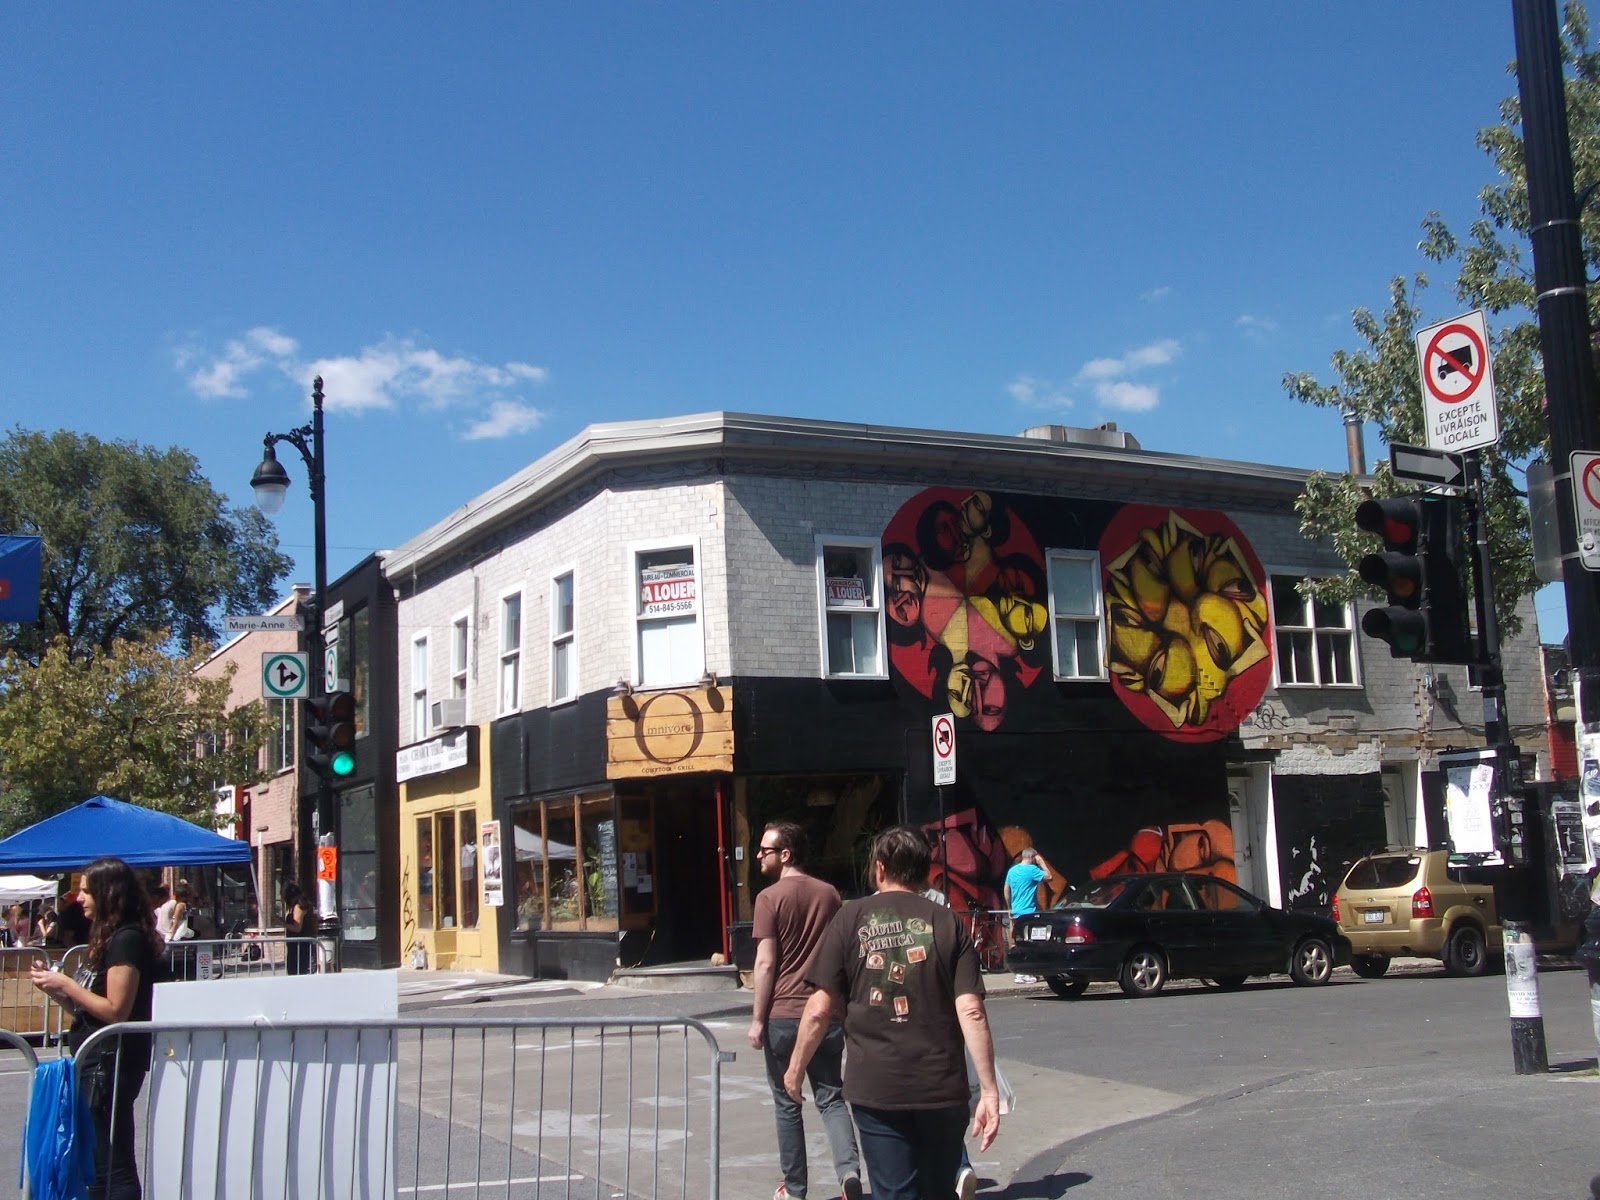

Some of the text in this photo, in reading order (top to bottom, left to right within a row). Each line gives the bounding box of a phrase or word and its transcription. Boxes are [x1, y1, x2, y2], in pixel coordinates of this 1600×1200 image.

[1439, 401, 1481, 423] EXCEPTÉ
[1435, 413, 1487, 436] LIVRAISON
[1443, 426, 1480, 446] LOCALE
[654, 581, 695, 601] LOUER
[836, 587, 863, 600] LOUER
[229, 621, 285, 630] Marie-Anne
[859, 933, 915, 958] AMERICA
